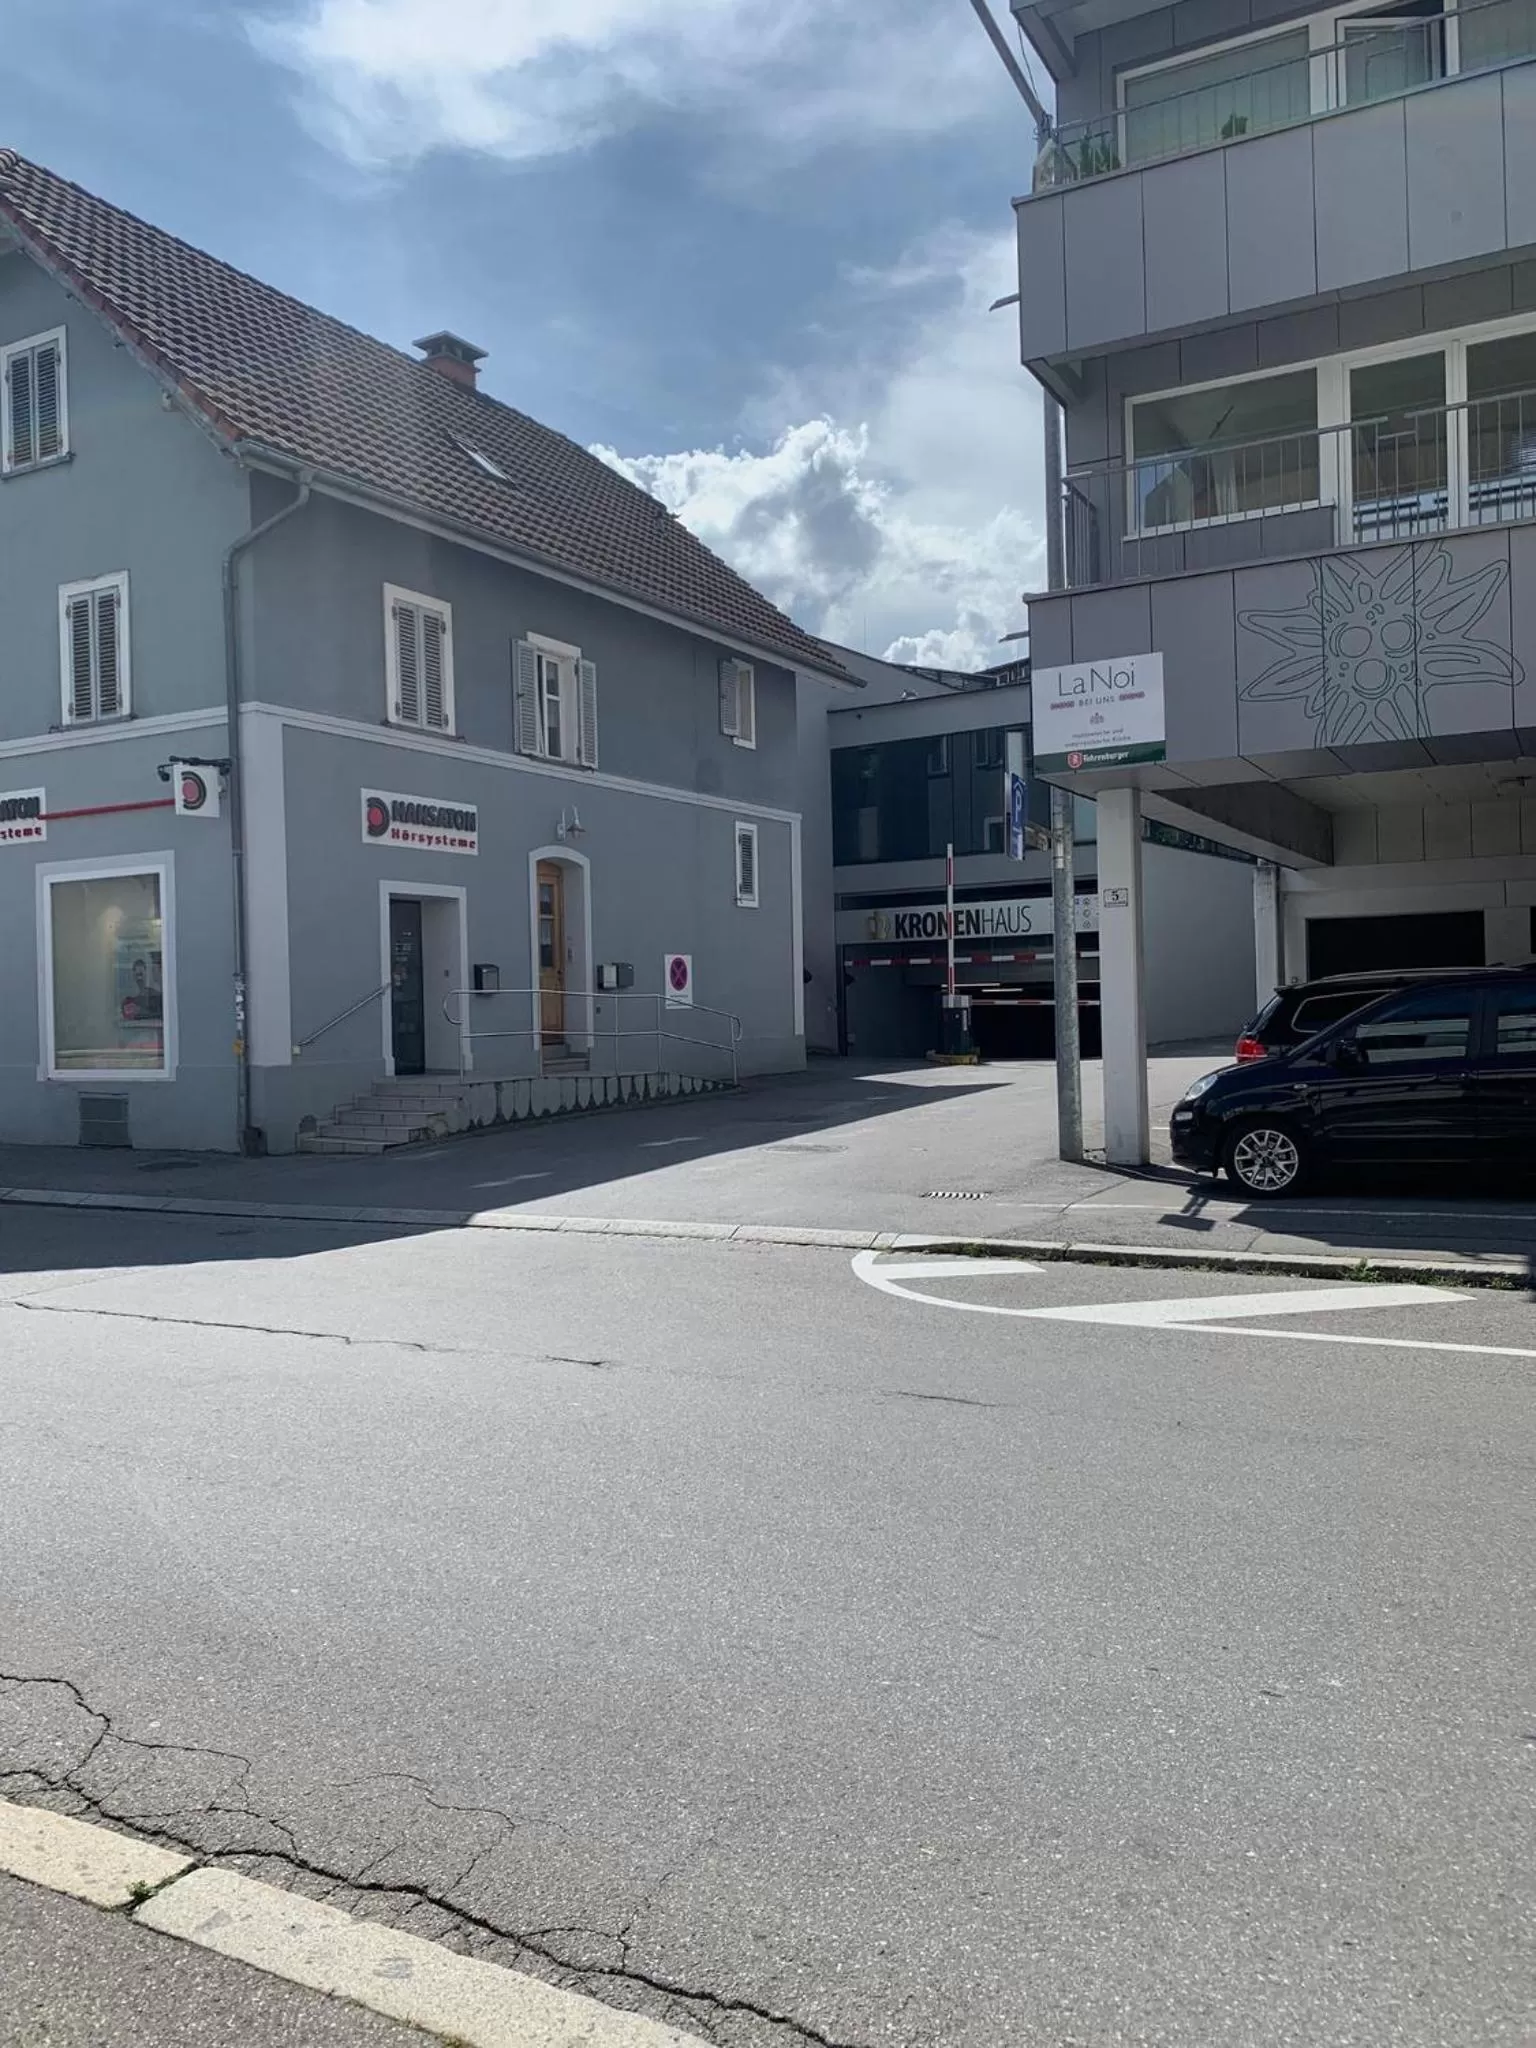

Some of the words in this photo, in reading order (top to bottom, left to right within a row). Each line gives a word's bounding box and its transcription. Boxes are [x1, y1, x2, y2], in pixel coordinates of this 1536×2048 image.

[391, 800, 476, 832] MANSATON
[391, 828, 476, 849] Hörsysteme
[894, 905, 1032, 939] KRONENHAUS
